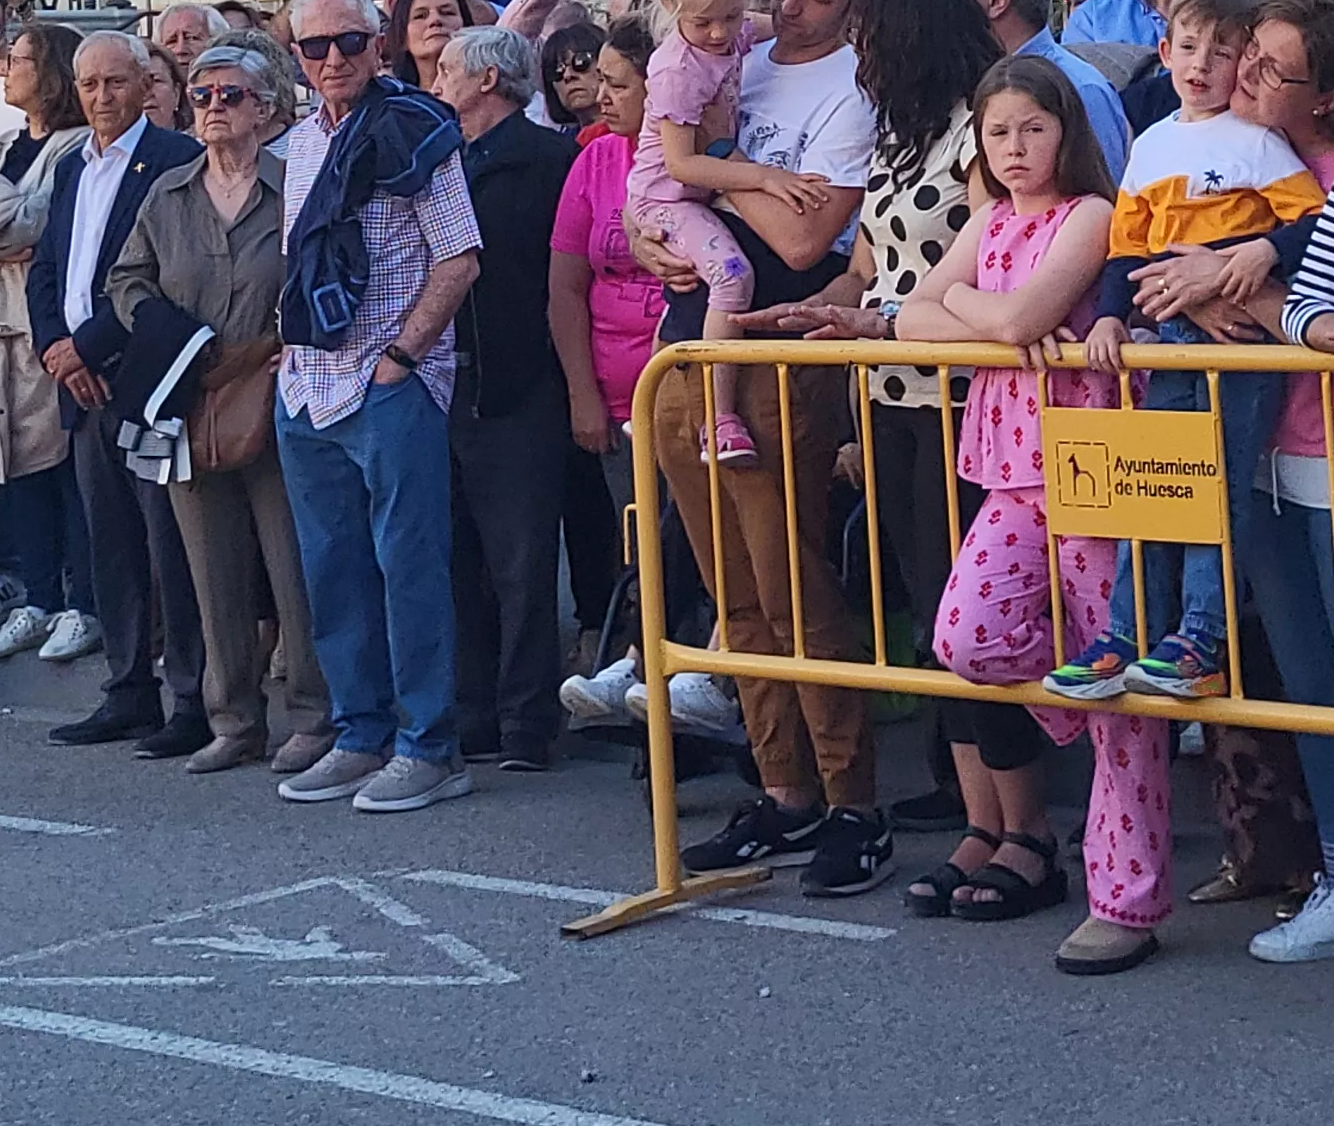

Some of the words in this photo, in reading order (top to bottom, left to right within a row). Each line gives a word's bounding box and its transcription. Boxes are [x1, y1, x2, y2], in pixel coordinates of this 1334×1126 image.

[1114, 455, 1217, 476] Ayuntamiento
[1114, 479, 1133, 496] de
[1137, 479, 1193, 499] Huesca
